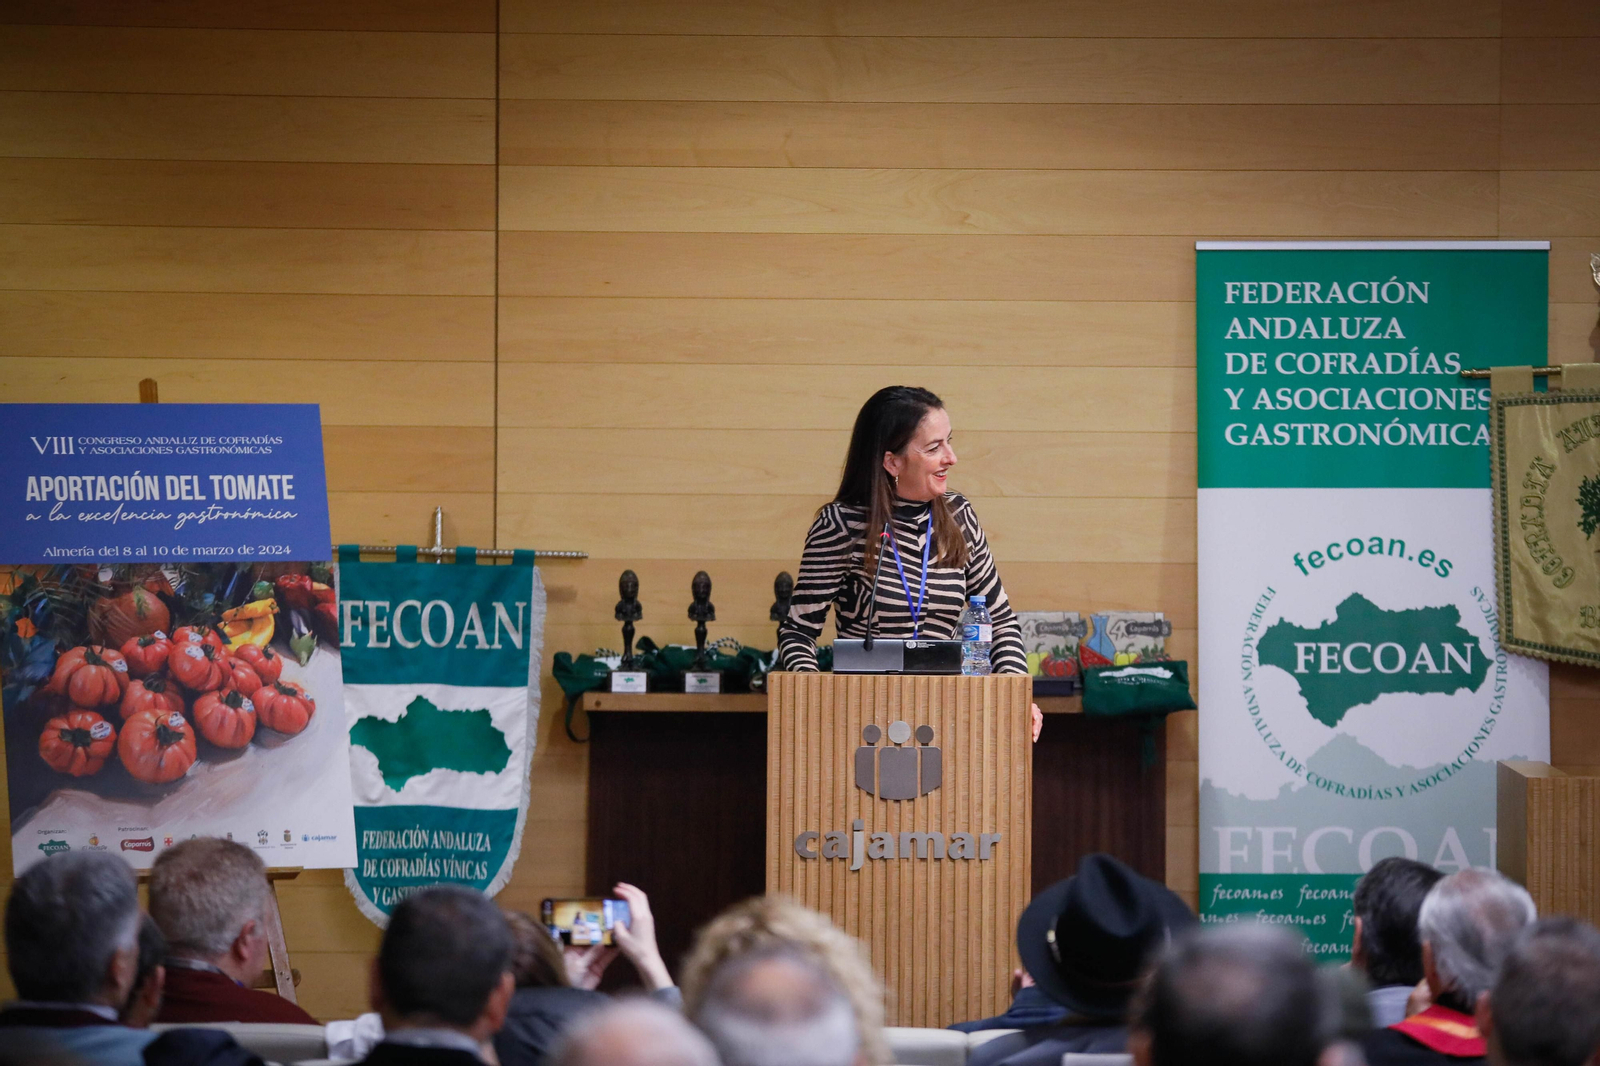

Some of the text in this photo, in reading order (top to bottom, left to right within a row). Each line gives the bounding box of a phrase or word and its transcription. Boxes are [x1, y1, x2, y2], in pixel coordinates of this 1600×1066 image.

[1224, 276, 1431, 304] FEDERACIÓN
[1224, 317, 1406, 339] ANDALUZA
[1224, 346, 1461, 375] DE COFRADÍAS
[1224, 387, 1491, 411] Y ASOCIACIONES
[30, 434, 283, 455] VIII CONGRESO ANDALUZ DE COFRADÍAS
[1224, 417, 1491, 446] GASTRONÓMICA
[79, 444, 272, 455] Y ASOCIACIONES GASTRONÓMICAS
[26, 470, 295, 501] APORTACIÓN DEL TOMATE
[26, 501, 298, 530] a la excelencia gastronómica
[43, 545, 291, 557] Almería del 8 al 10 de marzo de 2024
[1293, 535, 1453, 578] fecoan.es
[339, 599, 527, 650] FECOAN
[1241, 585, 1277, 681] FEDERACIÓN
[1294, 642, 1475, 675] FECOAN
[1243, 685, 1286, 763] ANDALUZA
[1286, 757, 1306, 777] DE
[1409, 717, 1496, 794] ASOCIACIONES
[1306, 772, 1393, 801] COFRADÍAS
[1395, 784, 1407, 798] Y
[311, 834, 337, 842] cajamar
[362, 824, 491, 852] FEDERACIÓN ANDALUZA
[795, 819, 1002, 871] cajamar
[363, 852, 488, 880] DE COFRADÍAS VÍNICAS
[373, 887, 381, 905] Y
[1209, 883, 1355, 909] fecoan.es fecoan.
